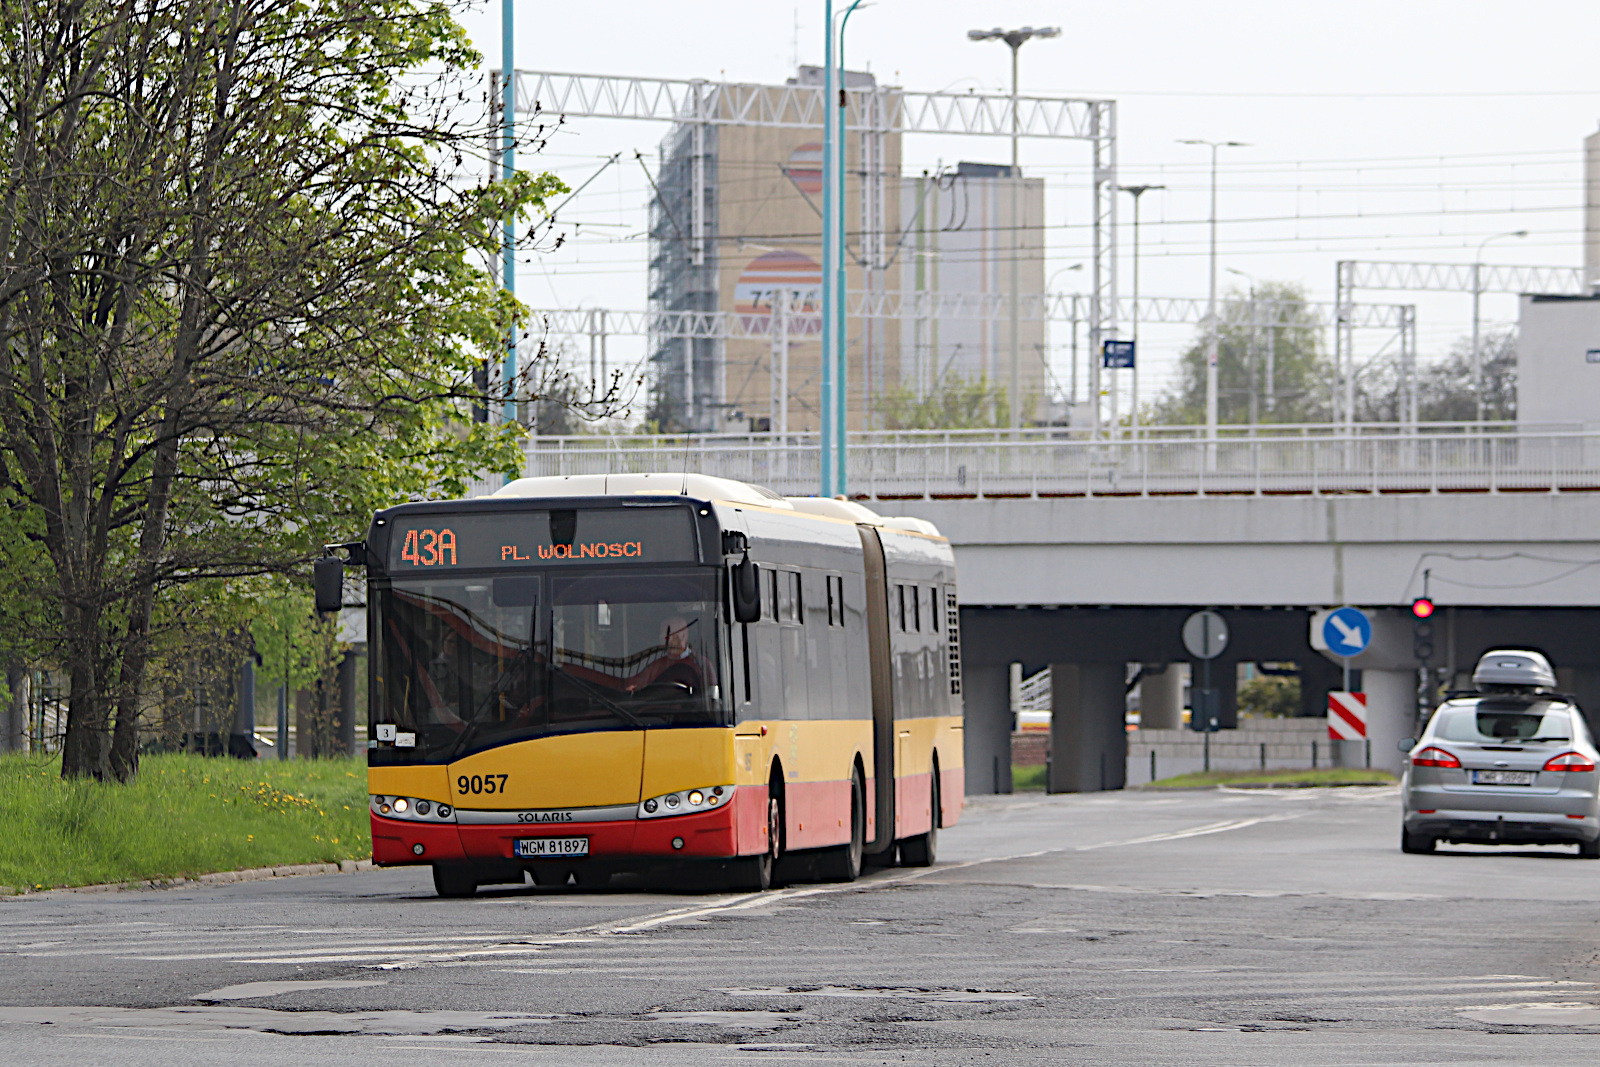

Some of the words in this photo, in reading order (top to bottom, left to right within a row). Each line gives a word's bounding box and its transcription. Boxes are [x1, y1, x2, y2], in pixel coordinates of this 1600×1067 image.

[401, 528, 457, 566] 43A
[501, 545, 531, 560] PL.
[383, 728, 389, 738] 3
[457, 774, 509, 794] 9057
[517, 812, 572, 822] SOLARIS
[521, 841, 545, 854] WGM
[549, 839, 587, 853] 81897
